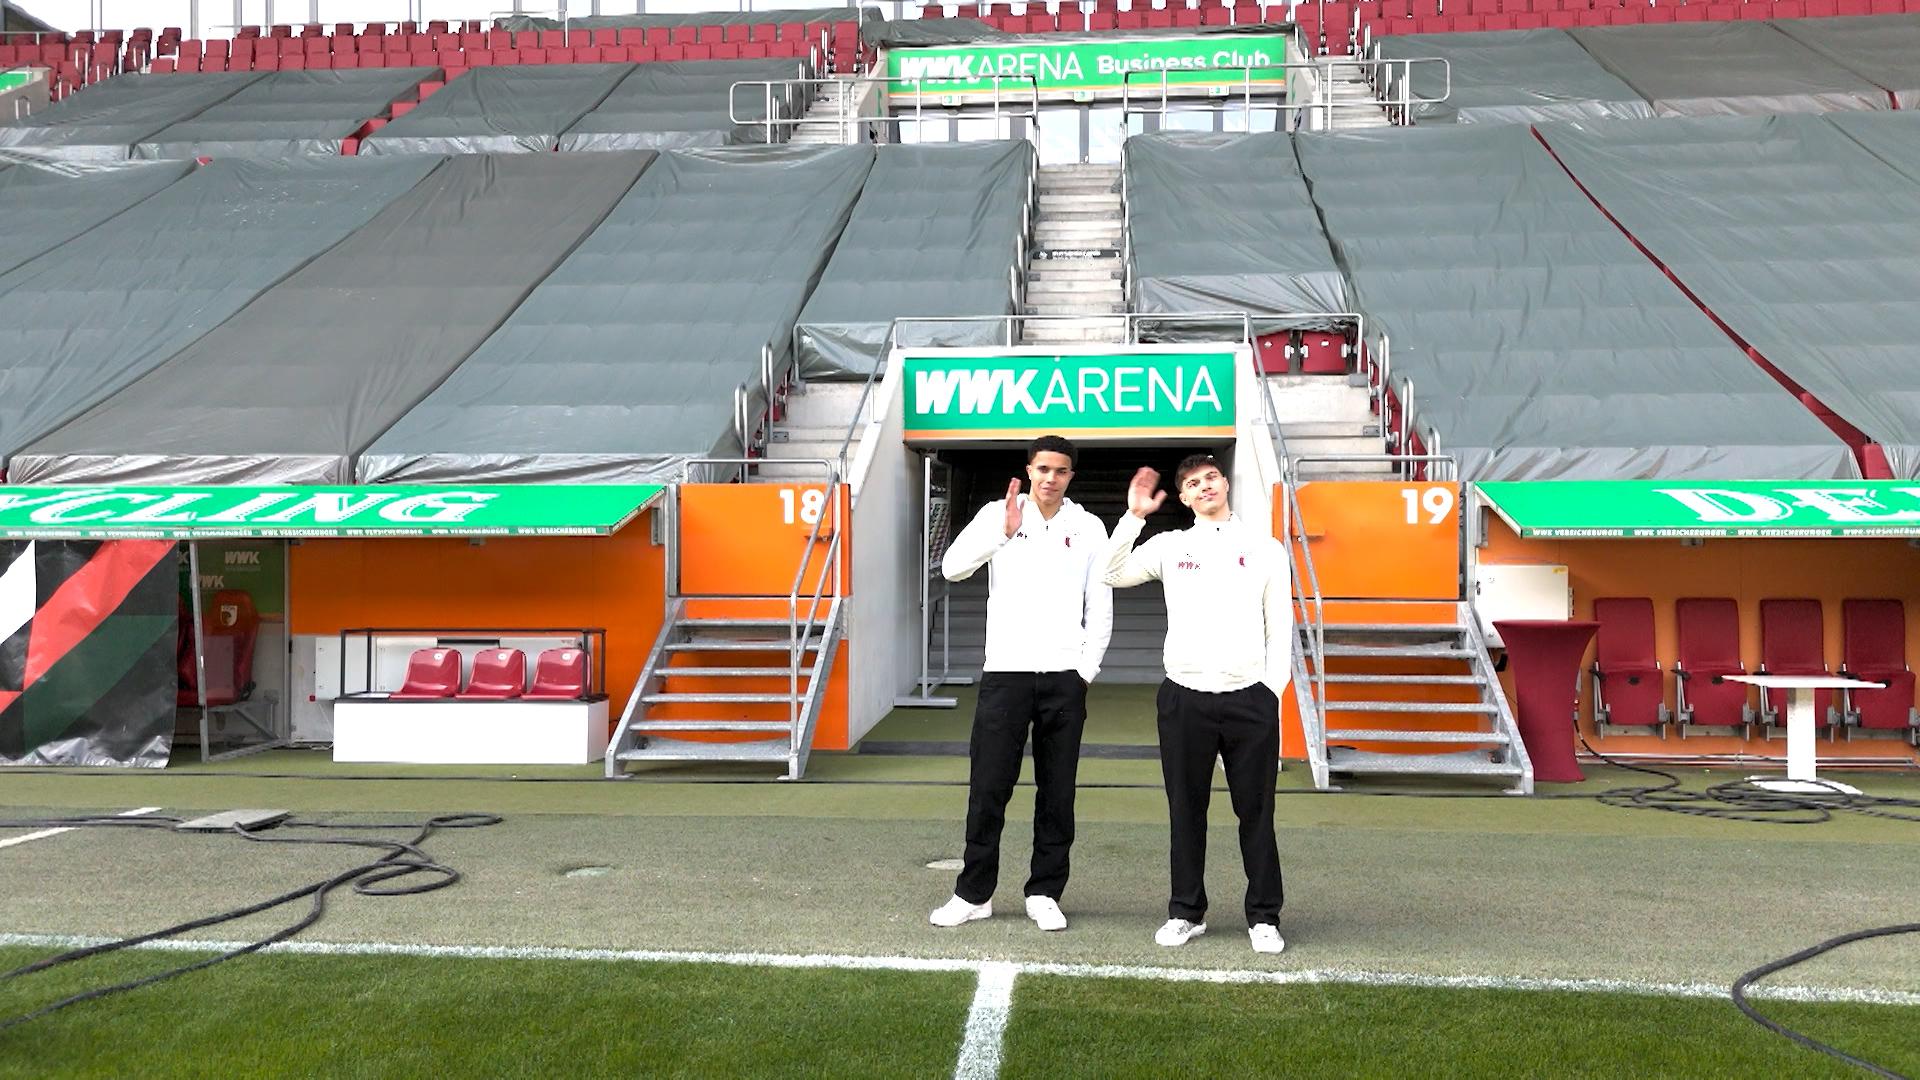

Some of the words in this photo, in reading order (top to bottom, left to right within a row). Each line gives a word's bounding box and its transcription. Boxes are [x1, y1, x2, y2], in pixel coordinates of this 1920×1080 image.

[1097, 53, 1207, 74] Business
[1213, 49, 1271, 67] Club
[779, 488, 826, 525] 18
[1401, 486, 1454, 525] 19
[1652, 487, 1920, 523] DE
[224, 551, 260, 564] WWK
